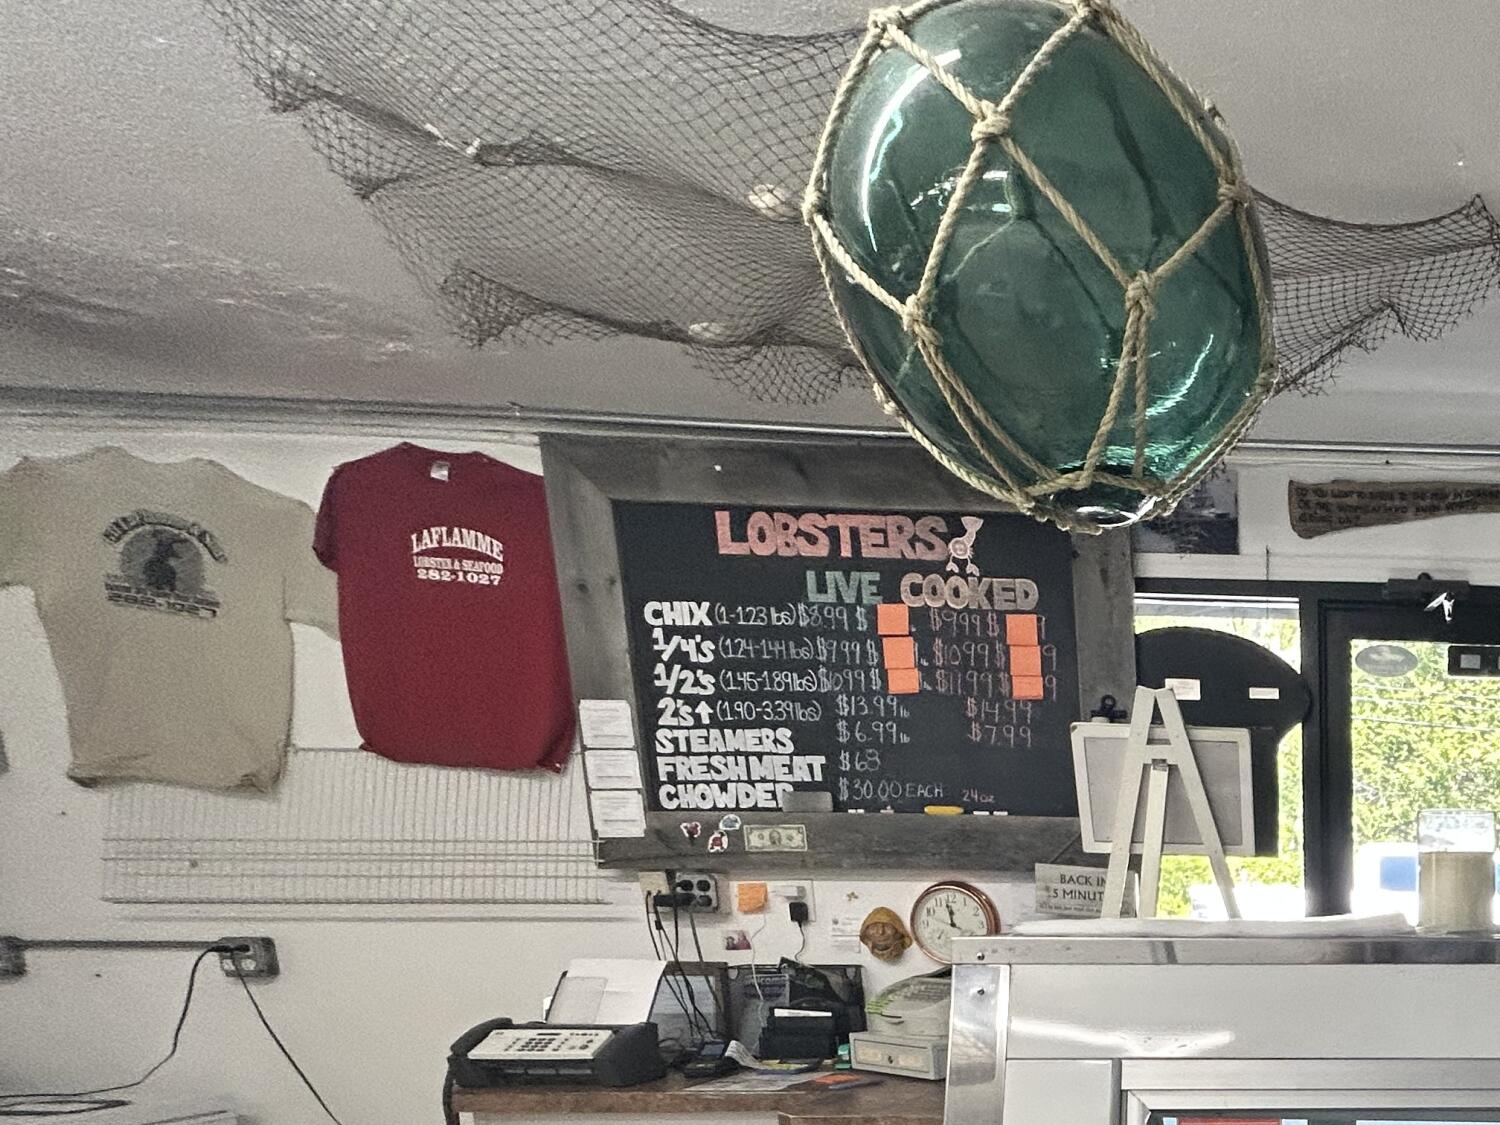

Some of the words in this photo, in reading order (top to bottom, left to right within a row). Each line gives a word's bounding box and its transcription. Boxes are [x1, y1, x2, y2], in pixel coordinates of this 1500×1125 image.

[410, 526, 503, 562] LAFLAMME
[714, 510, 949, 561] LOBSTERS
[417, 568, 501, 586] 282-1027
[462, 560, 503, 574] SEAFOOD
[806, 570, 883, 604] LIVE
[900, 572, 1039, 610] COOKED
[644, 601, 712, 626] CHIX
[657, 697, 695, 726] 2's
[655, 727, 795, 754] STEAMERS
[656, 755, 747, 781] FRESH
[748, 755, 826, 781] MEAT
[905, 783, 944, 798] EACH
[1060, 874, 1092, 886] BACK
[1063, 888, 1105, 901] MINUT
